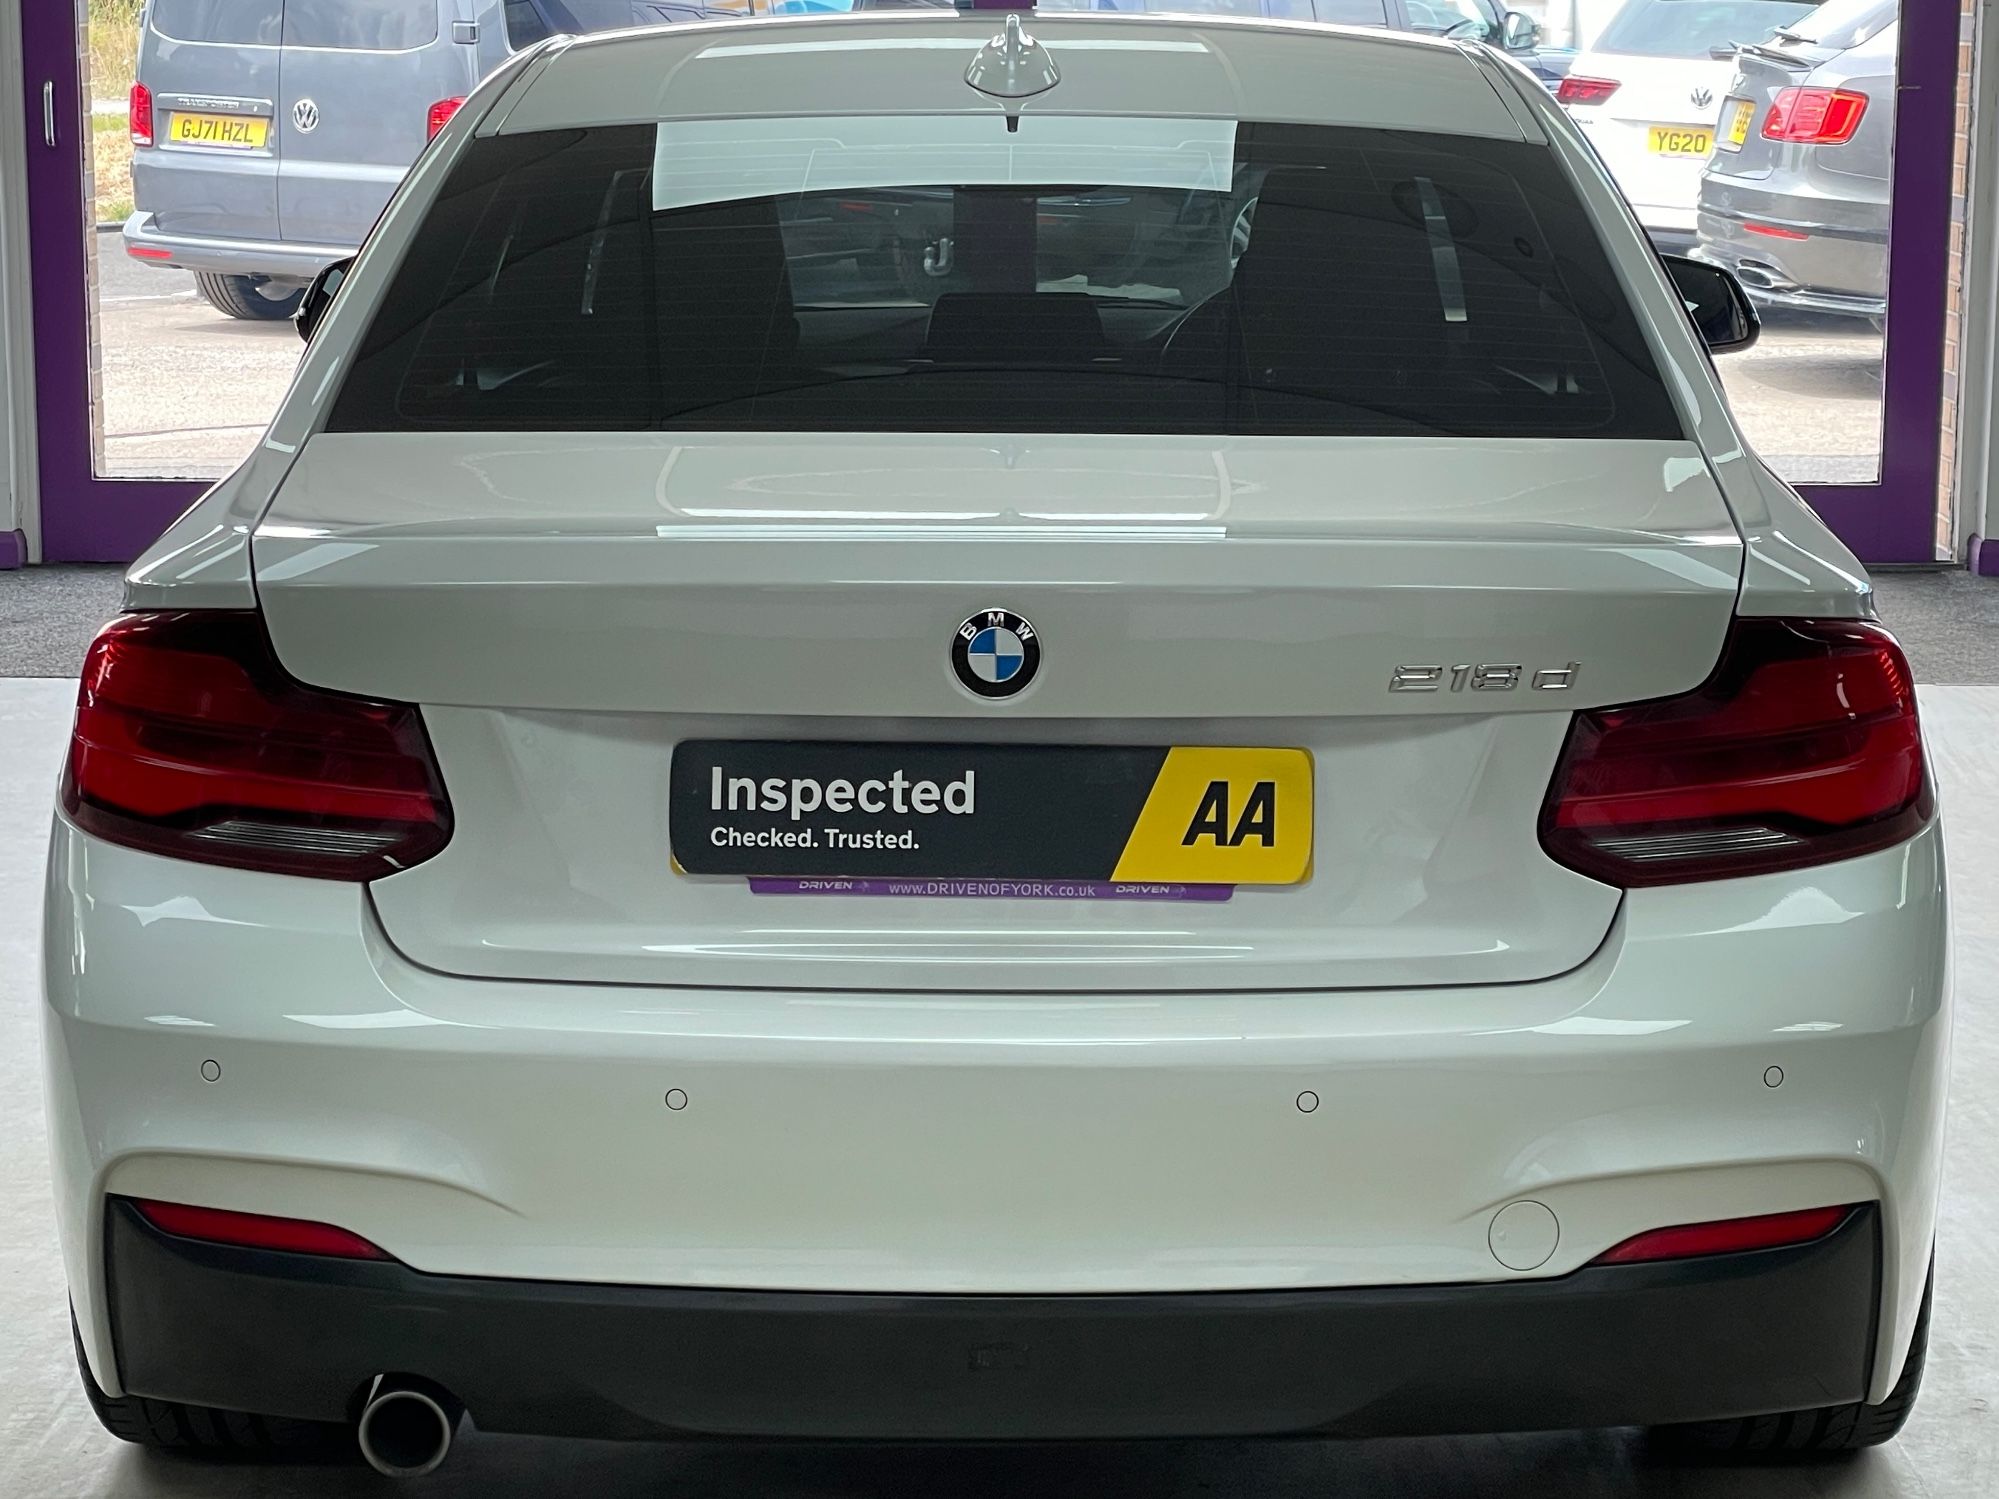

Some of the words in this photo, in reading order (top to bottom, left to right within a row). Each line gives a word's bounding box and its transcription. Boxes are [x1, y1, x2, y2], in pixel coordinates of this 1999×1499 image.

[181, 119, 218, 140] GJ71
[221, 120, 253, 143] HZL
[1657, 131, 1707, 153] YG20
[959, 612, 1034, 640] BMW
[1389, 663, 1522, 693] 218
[1531, 661, 1583, 691] d
[710, 766, 975, 821] Inspected
[1181, 780, 1276, 847] AA
[710, 827, 819, 848] Checked.
[824, 828, 919, 849] Trusted.
[798, 880, 853, 890] DRIVEN
[888, 882, 1096, 898] www.DRIVENOFYORK.co.uk
[1115, 885, 1170, 894] DRIVEN
